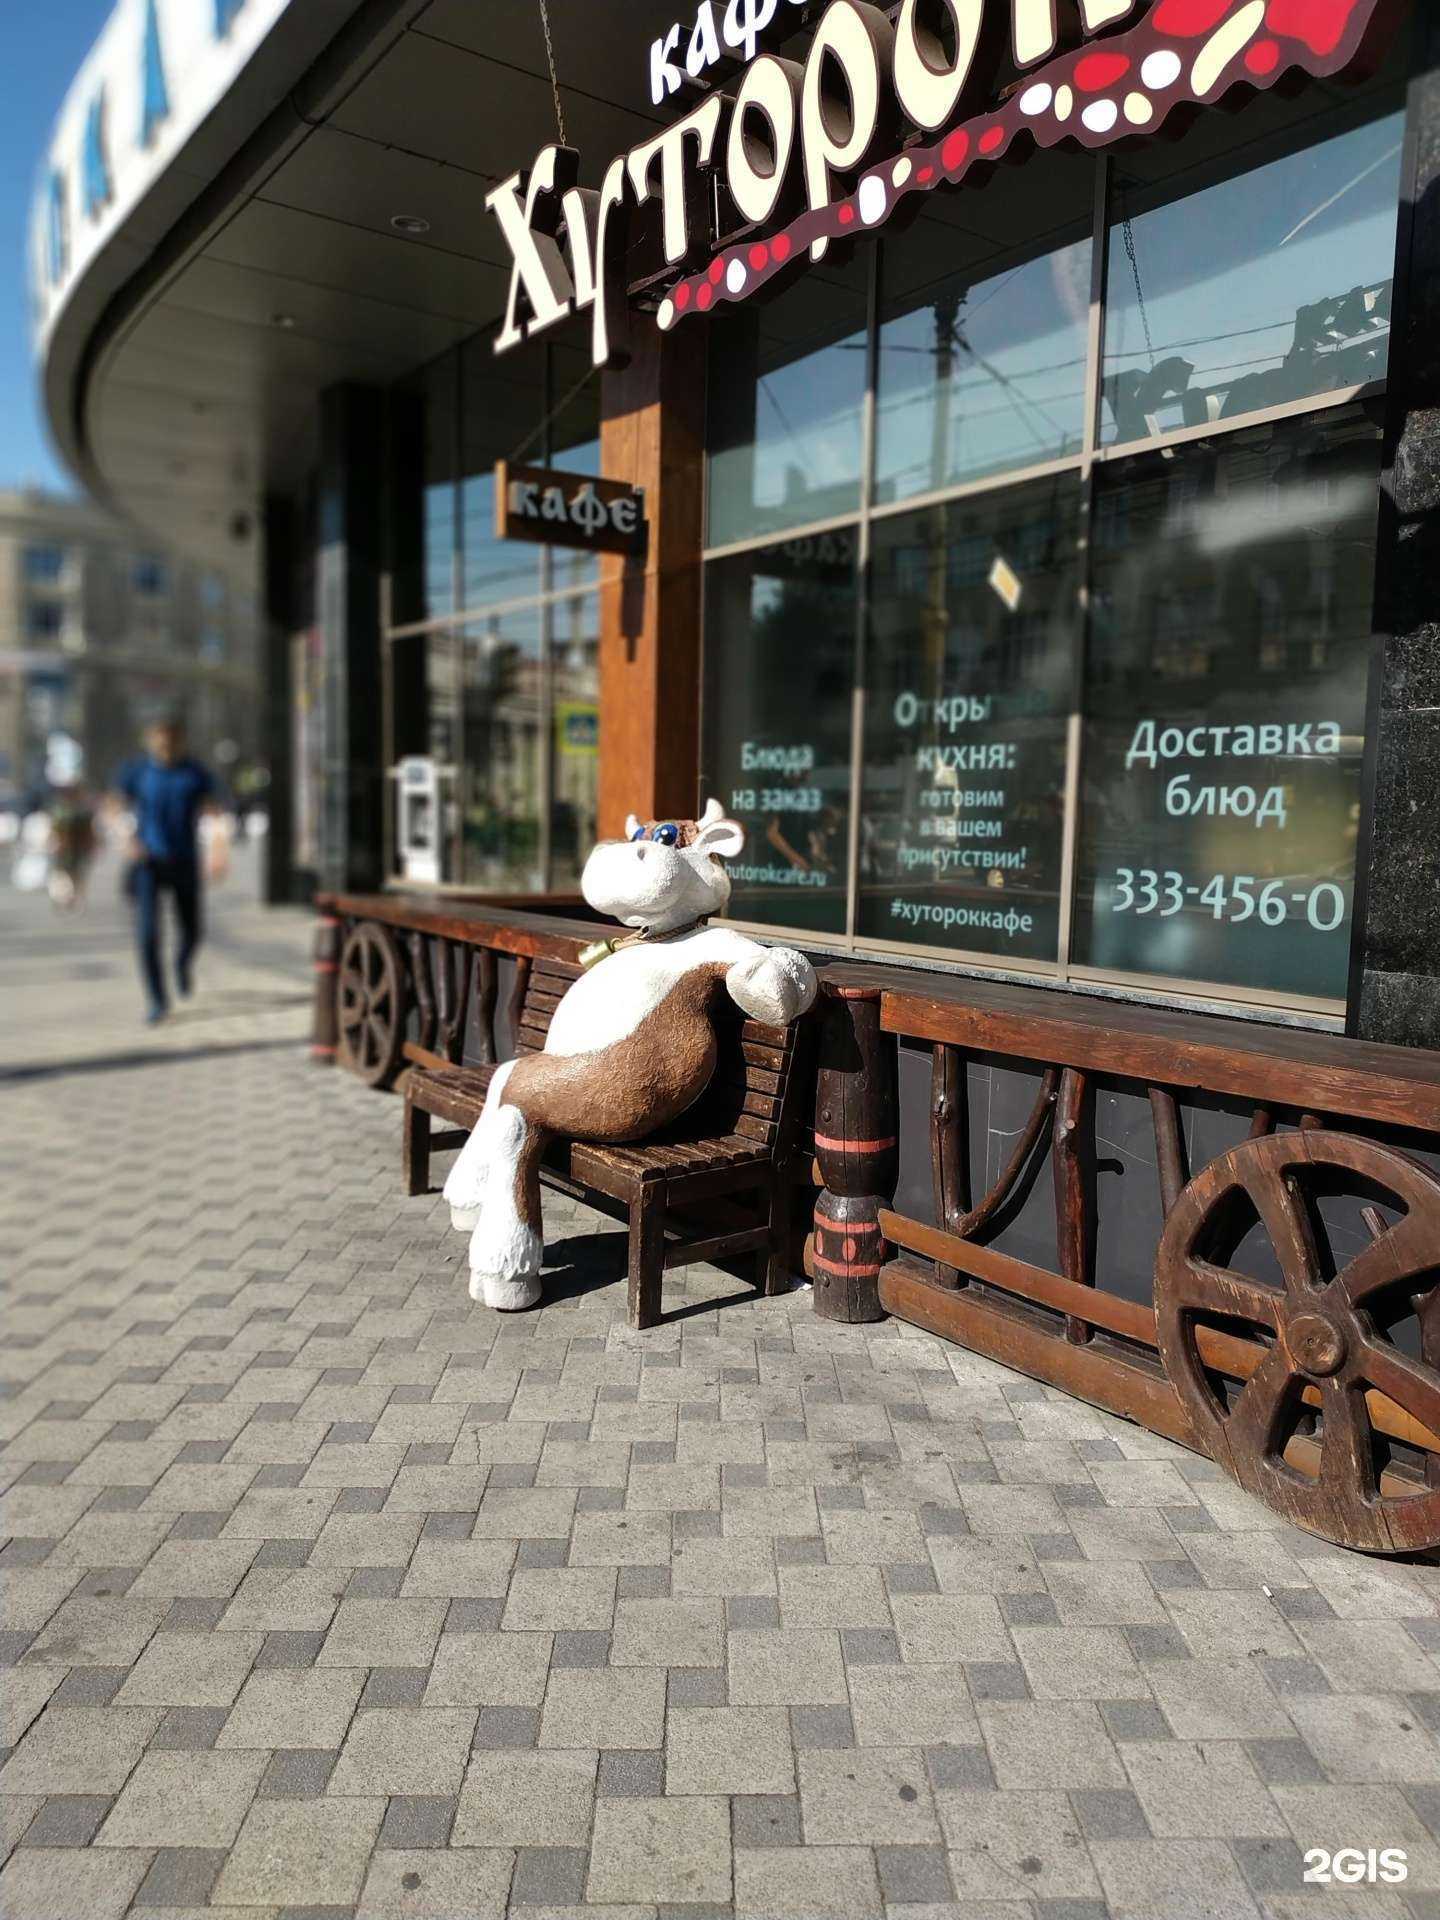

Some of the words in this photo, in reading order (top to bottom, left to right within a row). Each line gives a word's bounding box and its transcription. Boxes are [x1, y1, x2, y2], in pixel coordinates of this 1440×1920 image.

[650, 0, 807, 105] каф
[508, 480, 638, 537] кафе
[741, 742, 814, 777] Блюда
[916, 743, 1017, 770] кухня:
[1125, 720, 1341, 769] Доставка
[731, 789, 756, 810] на
[760, 787, 822, 811] заказ
[920, 789, 1004, 808] готовим
[1165, 774, 1287, 829] блюд
[935, 819, 1002, 837] вашем
[890, 898, 1033, 938] #хутороккафе
[1112, 868, 1345, 931] 333-456-0
